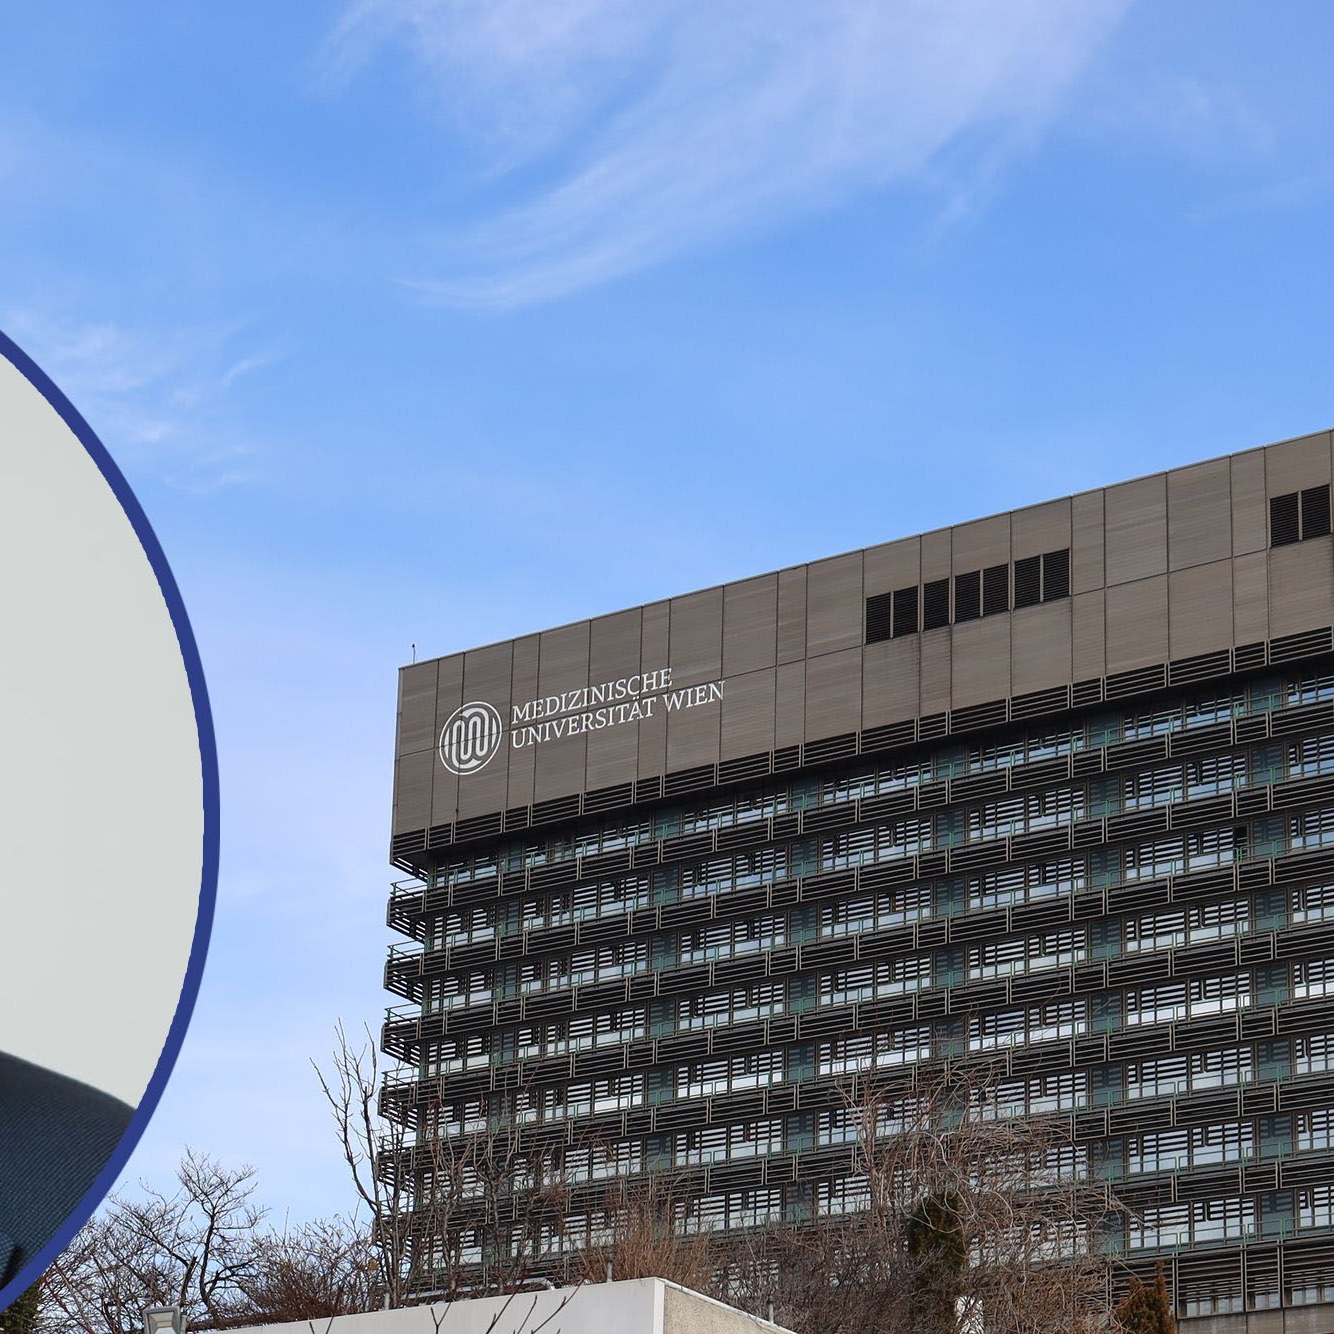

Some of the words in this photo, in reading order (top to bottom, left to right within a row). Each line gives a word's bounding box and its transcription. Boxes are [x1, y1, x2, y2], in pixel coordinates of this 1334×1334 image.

[511, 667, 673, 724] MEDIZINISCHE
[511, 697, 656, 749] UNIVERSITÄT
[662, 680, 726, 712] WIEN
